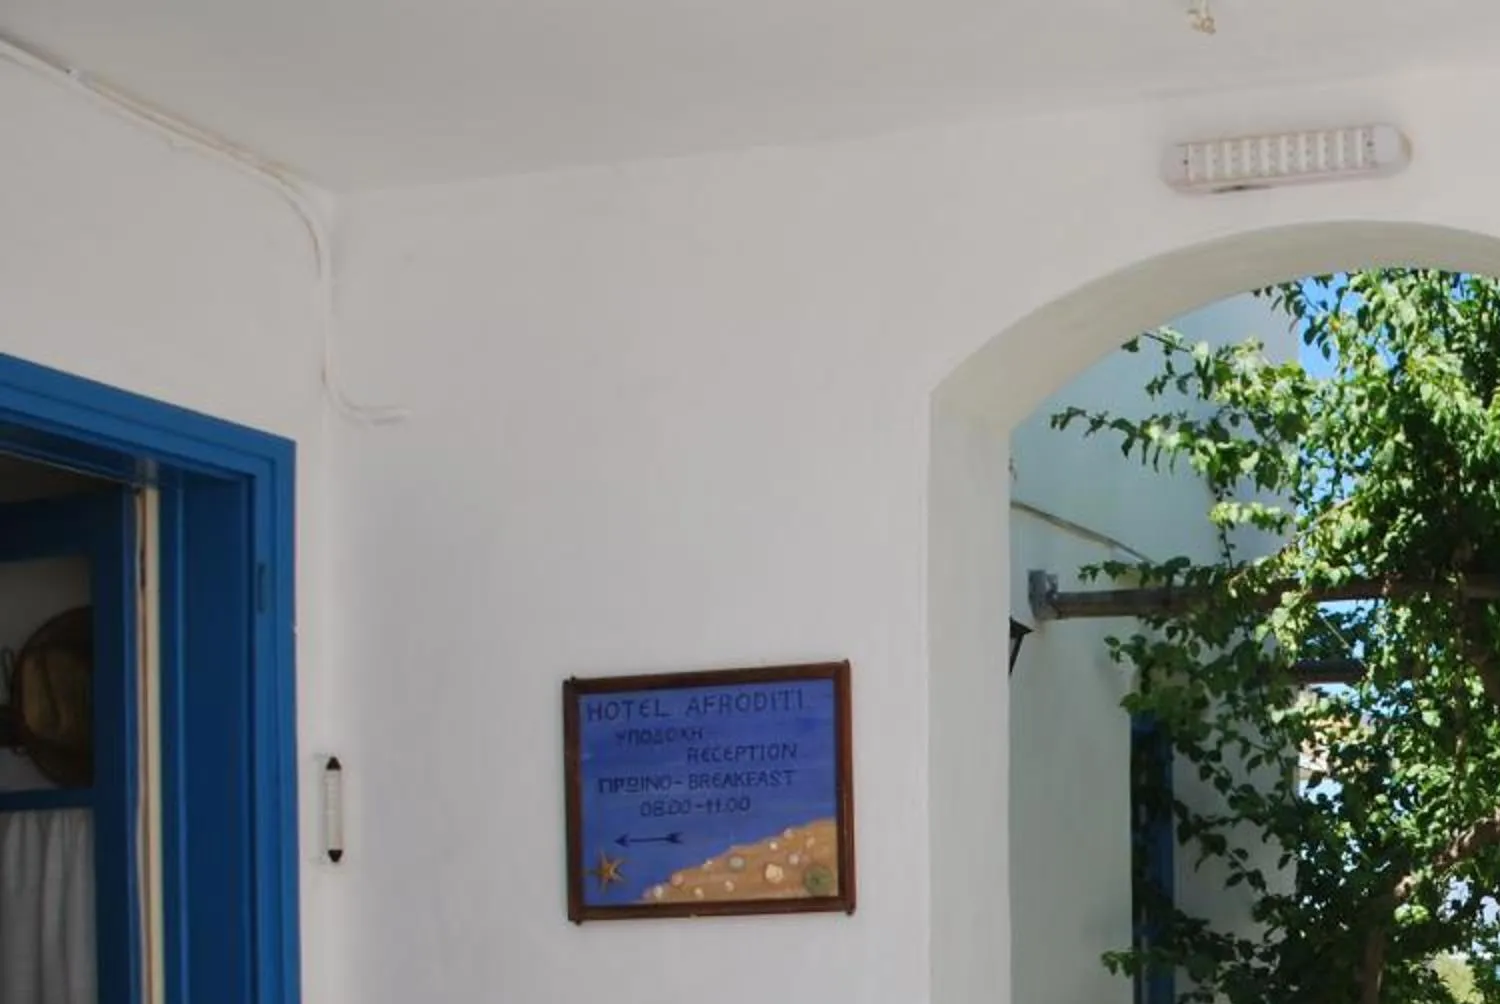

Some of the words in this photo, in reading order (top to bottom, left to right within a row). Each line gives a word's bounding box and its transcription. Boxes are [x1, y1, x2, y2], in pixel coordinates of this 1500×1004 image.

[586, 698, 673, 722] HOTEL
[684, 688, 804, 718] AFRODITI
[686, 743, 798, 763] RECEPTION
